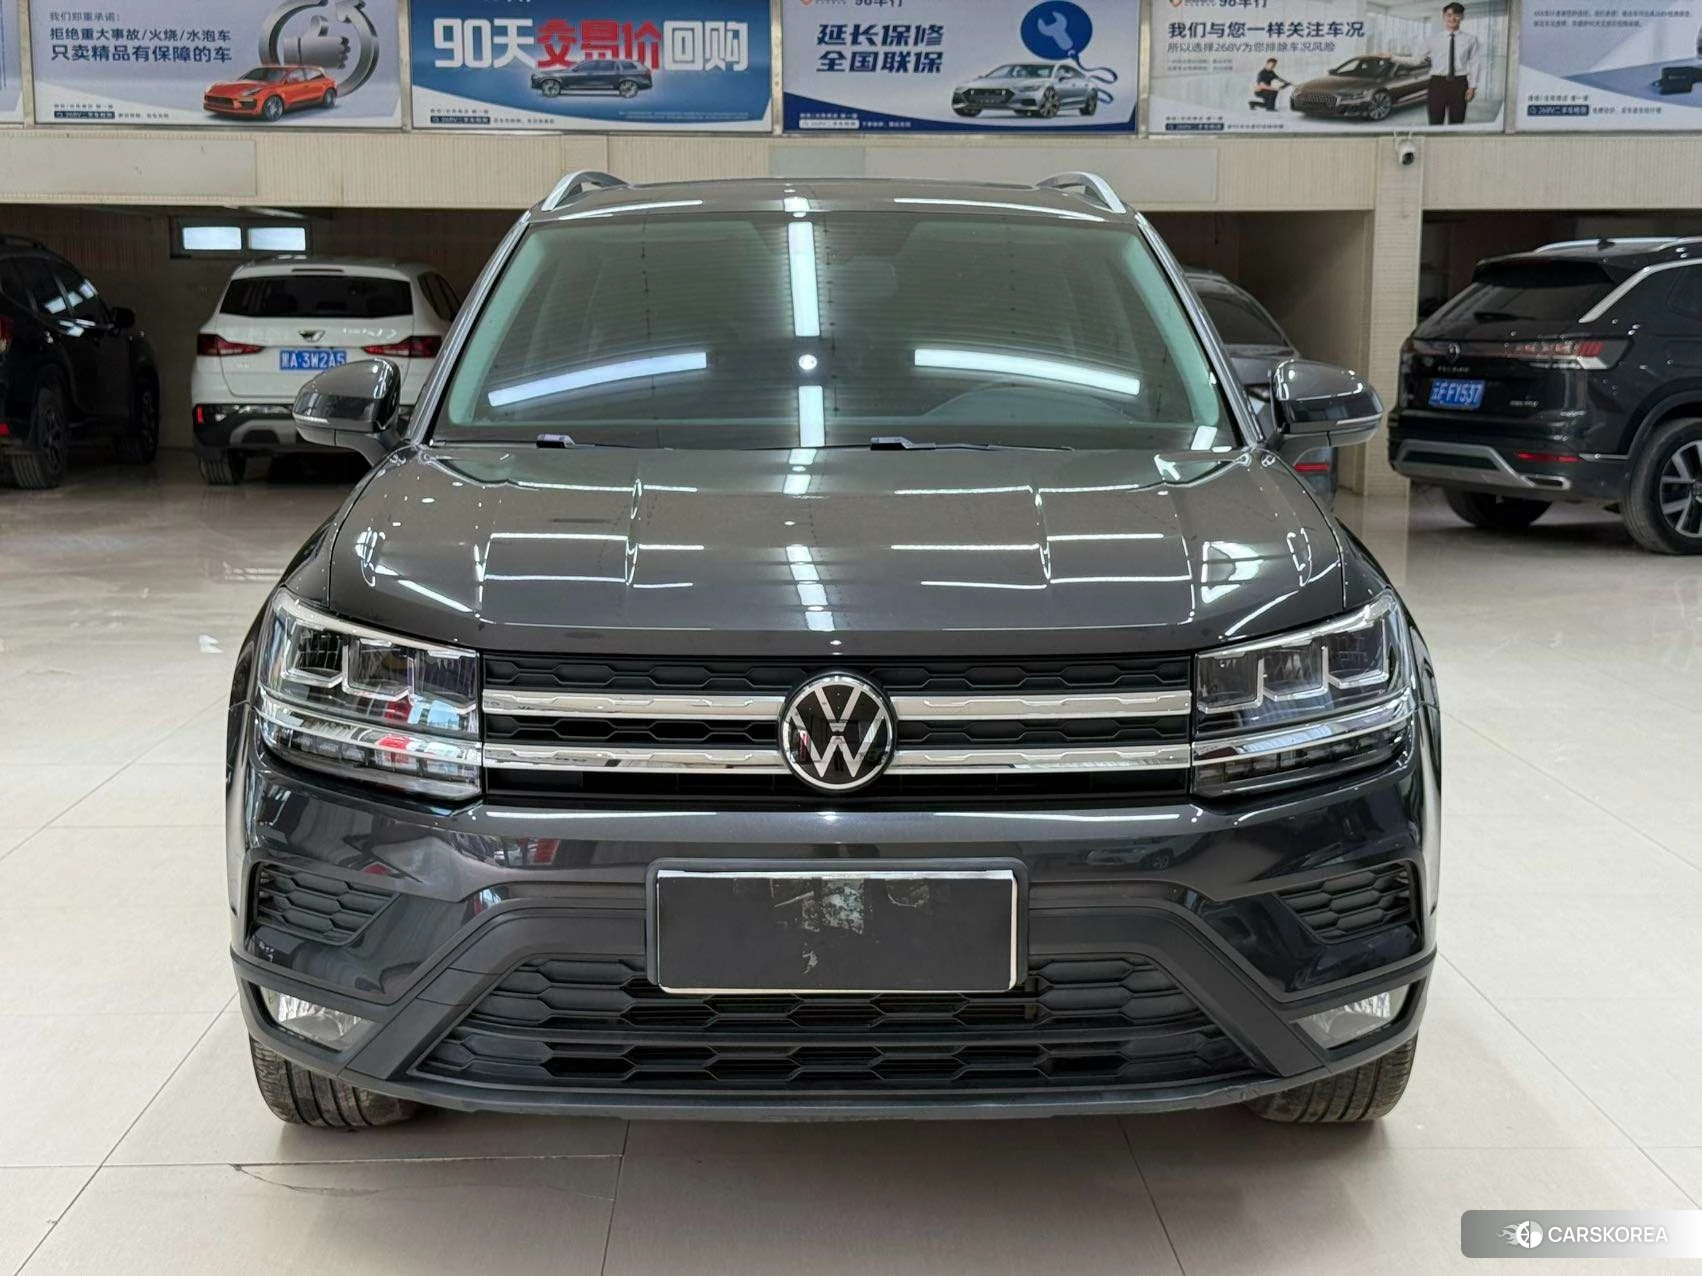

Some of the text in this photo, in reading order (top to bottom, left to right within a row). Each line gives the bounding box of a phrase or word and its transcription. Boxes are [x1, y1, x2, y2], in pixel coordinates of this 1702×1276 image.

[50, 28, 232, 42] 拒绝重大事故/火烧/水泡车
[816, 24, 944, 46] 延长保修
[1168, 21, 1365, 38] 我们与您一样关注车况
[51, 44, 232, 63] 只卖精品有保障的车
[433, 18, 749, 71] 90天交易价回购
[816, 51, 943, 73] 全国联保
